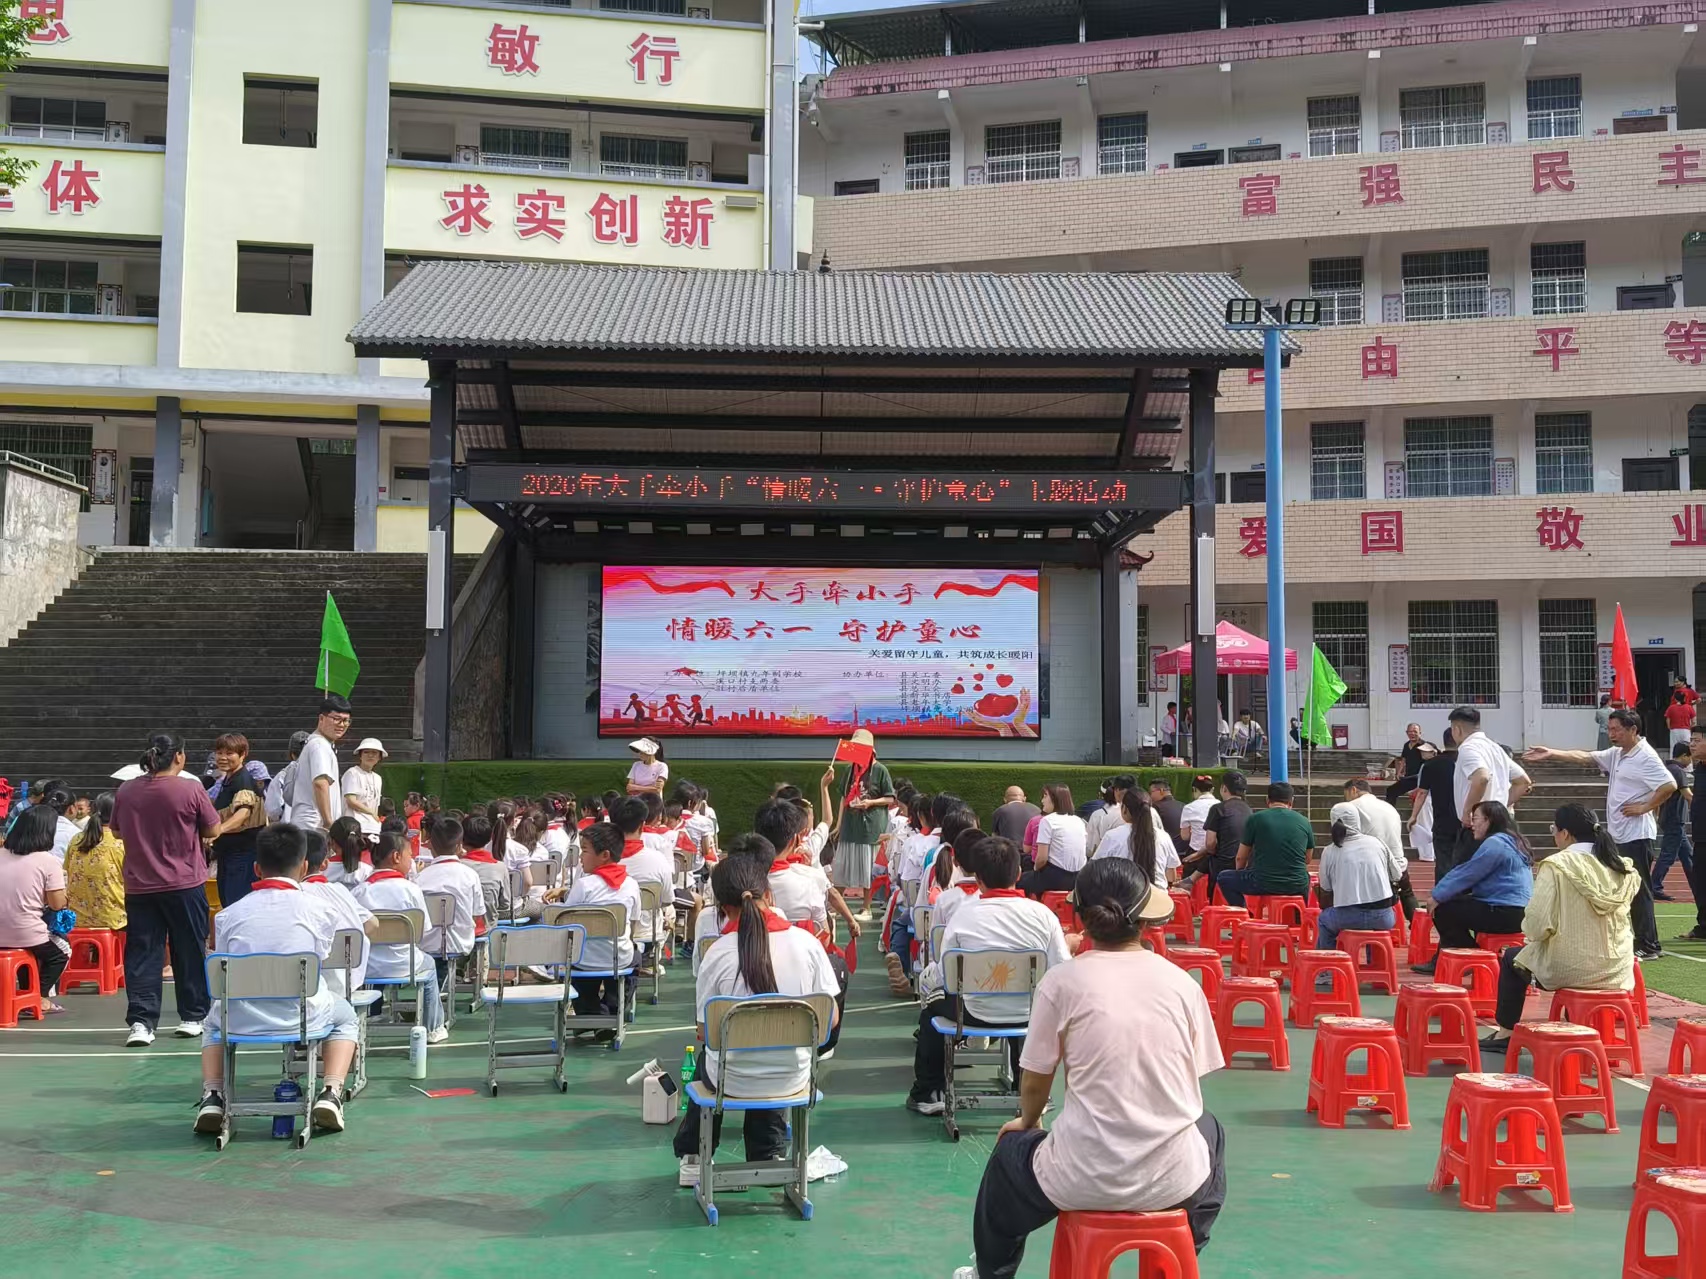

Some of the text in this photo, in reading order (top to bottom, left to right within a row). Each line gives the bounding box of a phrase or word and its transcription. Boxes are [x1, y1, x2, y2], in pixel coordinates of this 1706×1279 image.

[488, 24, 681, 85] 敏行
[1238, 143, 1706, 217] 富强 民主
[440, 184, 714, 248] 求实创新
[1533, 320, 1706, 373] 平等
[1239, 504, 1706, 557] 爱国 敬业
[749, 581, 924, 606] 大手牵小手
[666, 618, 983, 643] 情暖六一 守护童心
